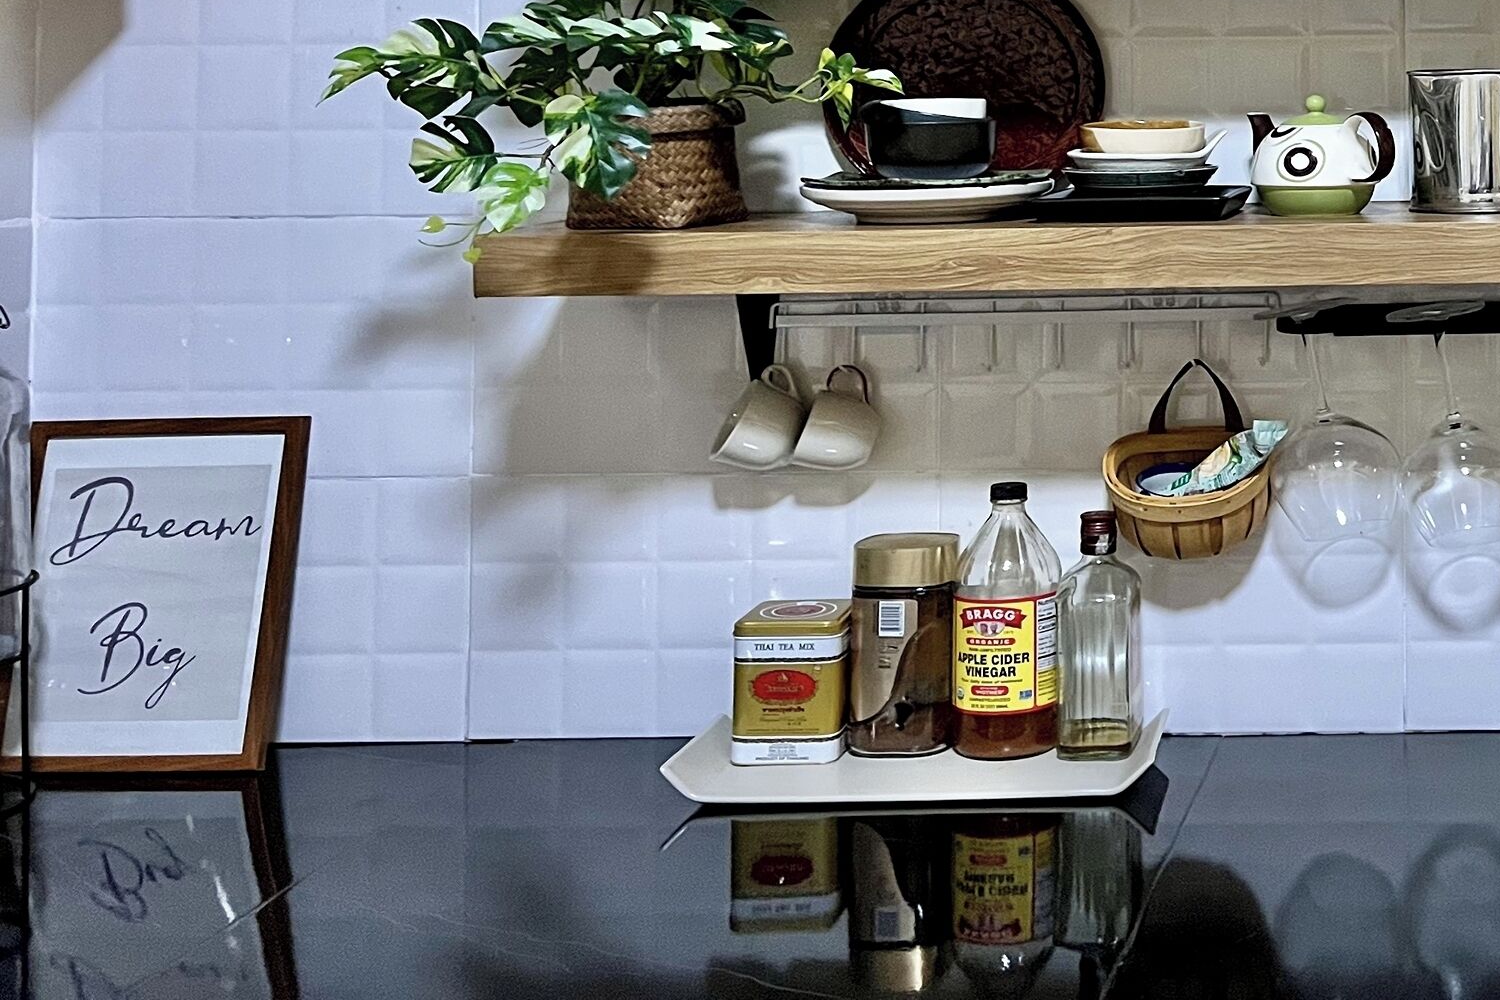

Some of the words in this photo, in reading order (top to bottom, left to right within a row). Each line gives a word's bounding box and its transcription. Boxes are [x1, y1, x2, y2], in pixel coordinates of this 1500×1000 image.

[49, 476, 263, 566] Dream
[966, 609, 1016, 620] BRAGG
[754, 643, 774, 651] THAI
[780, 643, 794, 651] TEA
[799, 643, 815, 651] MIX
[77, 602, 197, 710] Big
[958, 652, 987, 665] APPLE
[991, 652, 1030, 665] CIDER
[966, 666, 1017, 678] VINEGAR
